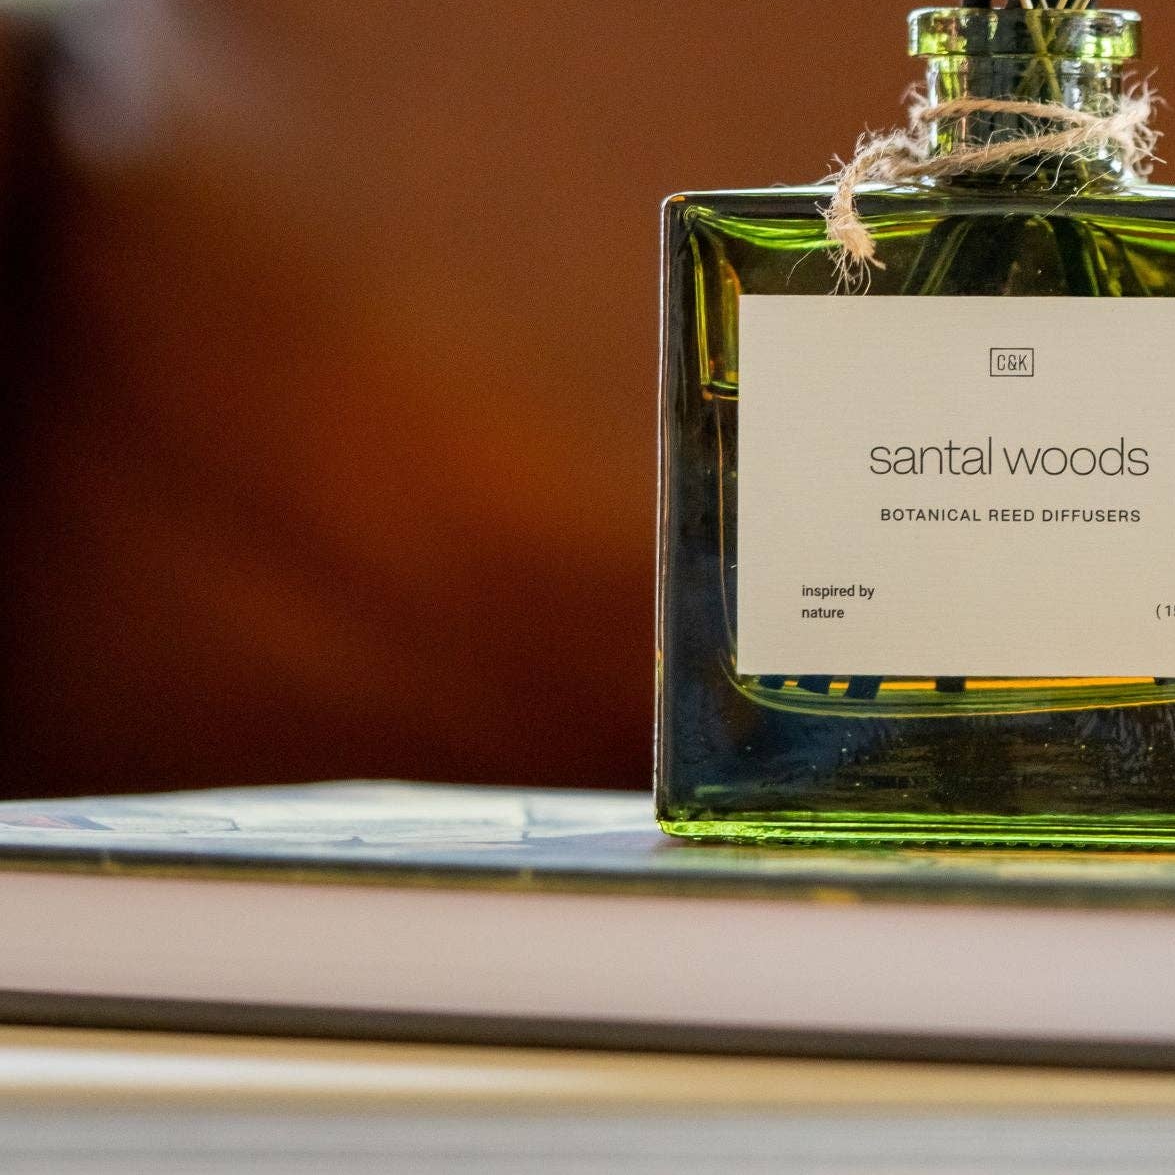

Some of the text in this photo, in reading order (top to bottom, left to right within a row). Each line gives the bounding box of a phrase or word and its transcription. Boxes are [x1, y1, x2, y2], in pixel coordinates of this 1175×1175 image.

[996, 353, 1028, 371] C&K
[869, 435, 1150, 477] santal woods
[880, 508, 1141, 523] BOTANICAL REED DIFFUSERS
[801, 584, 876, 601] inspired by
[801, 606, 845, 619] nature
